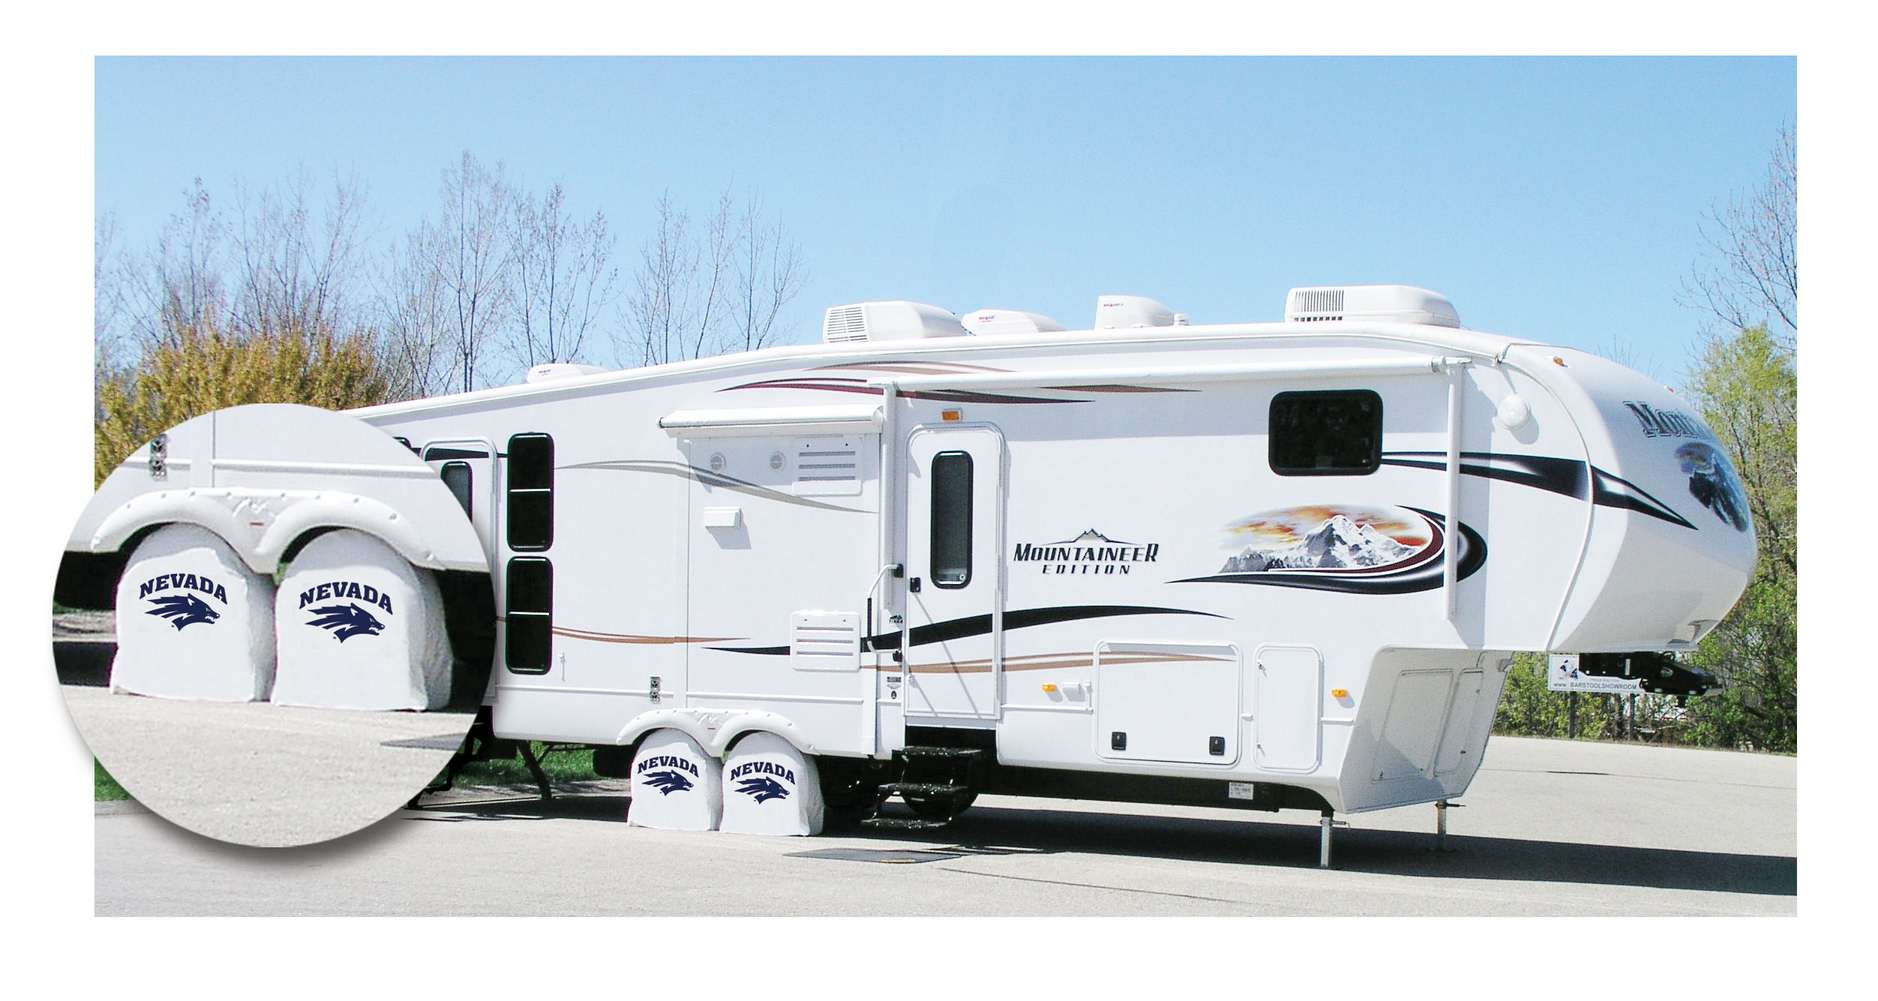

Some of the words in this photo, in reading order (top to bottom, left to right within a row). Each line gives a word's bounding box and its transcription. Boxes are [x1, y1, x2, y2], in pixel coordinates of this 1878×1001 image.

[1014, 543, 1159, 562] MOUNTAINEER
[1042, 564, 1130, 575] EDITION
[139, 573, 228, 605] NEVADA
[299, 581, 393, 615] NEVADA
[637, 755, 699, 778] NEVADA
[730, 761, 796, 785] NEVADA
